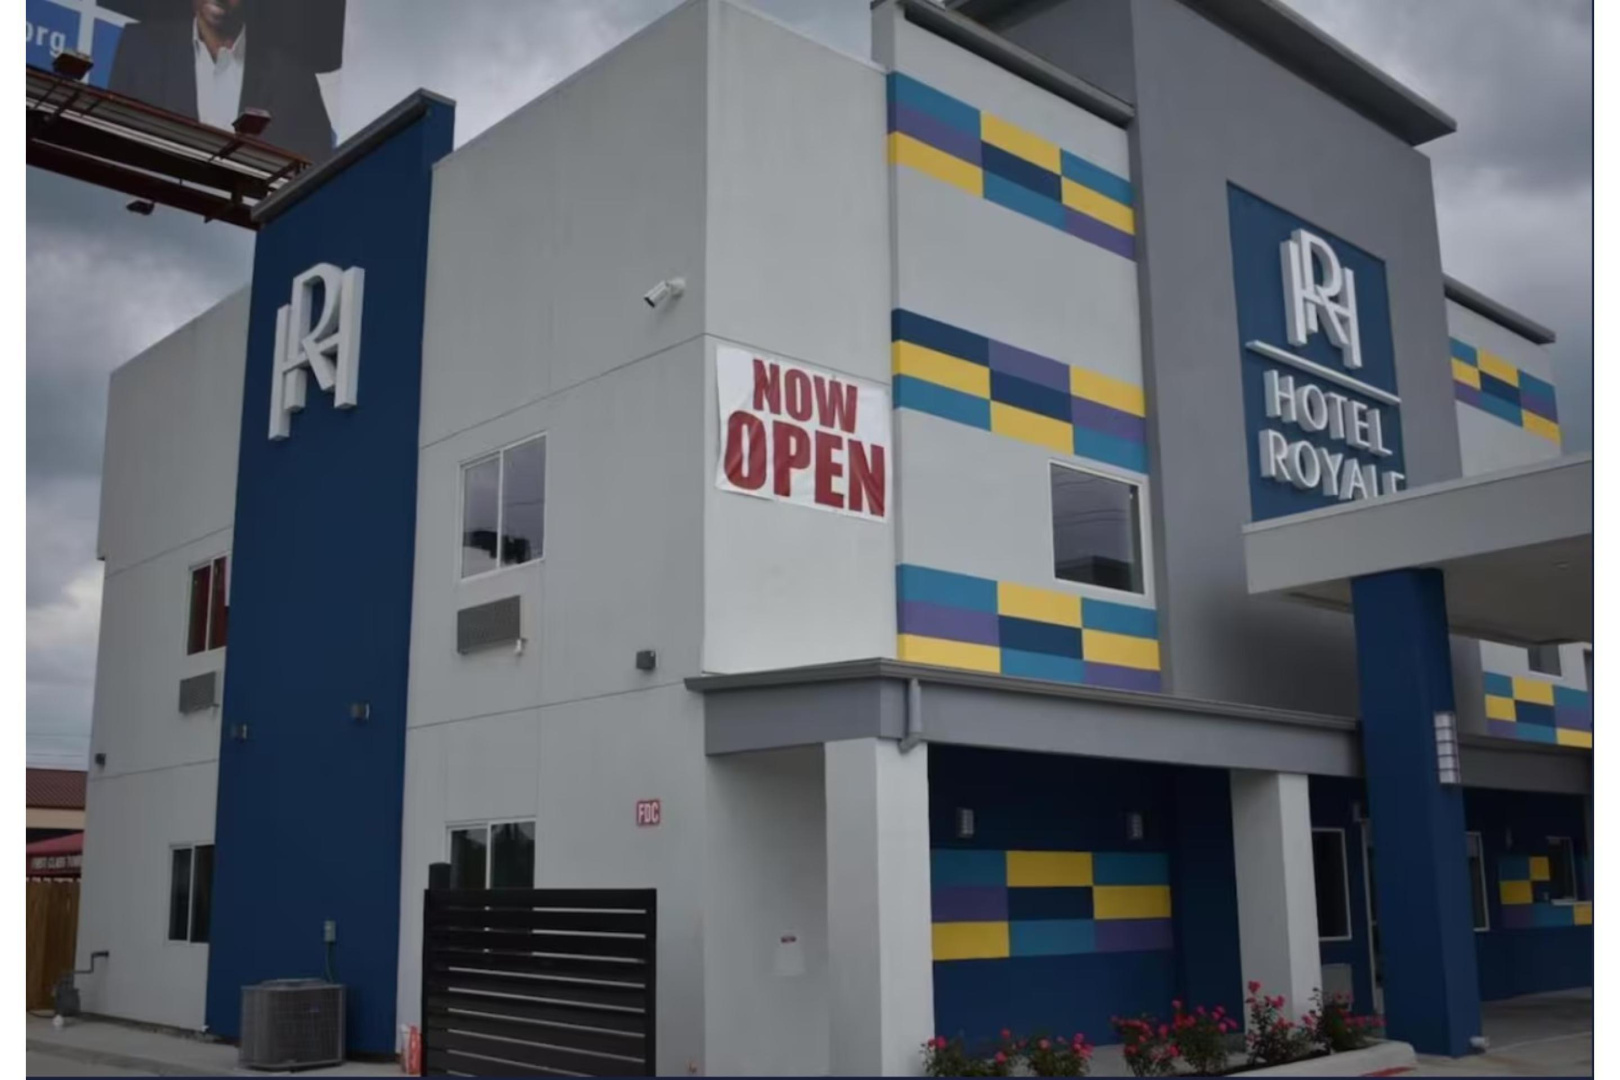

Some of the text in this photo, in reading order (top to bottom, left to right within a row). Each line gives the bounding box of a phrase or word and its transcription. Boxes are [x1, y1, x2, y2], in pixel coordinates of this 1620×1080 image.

[753, 358, 858, 434] NOW
[1263, 369, 1393, 457] HOTEL
[724, 410, 886, 517] OPEN
[637, 801, 660, 824] FDC
